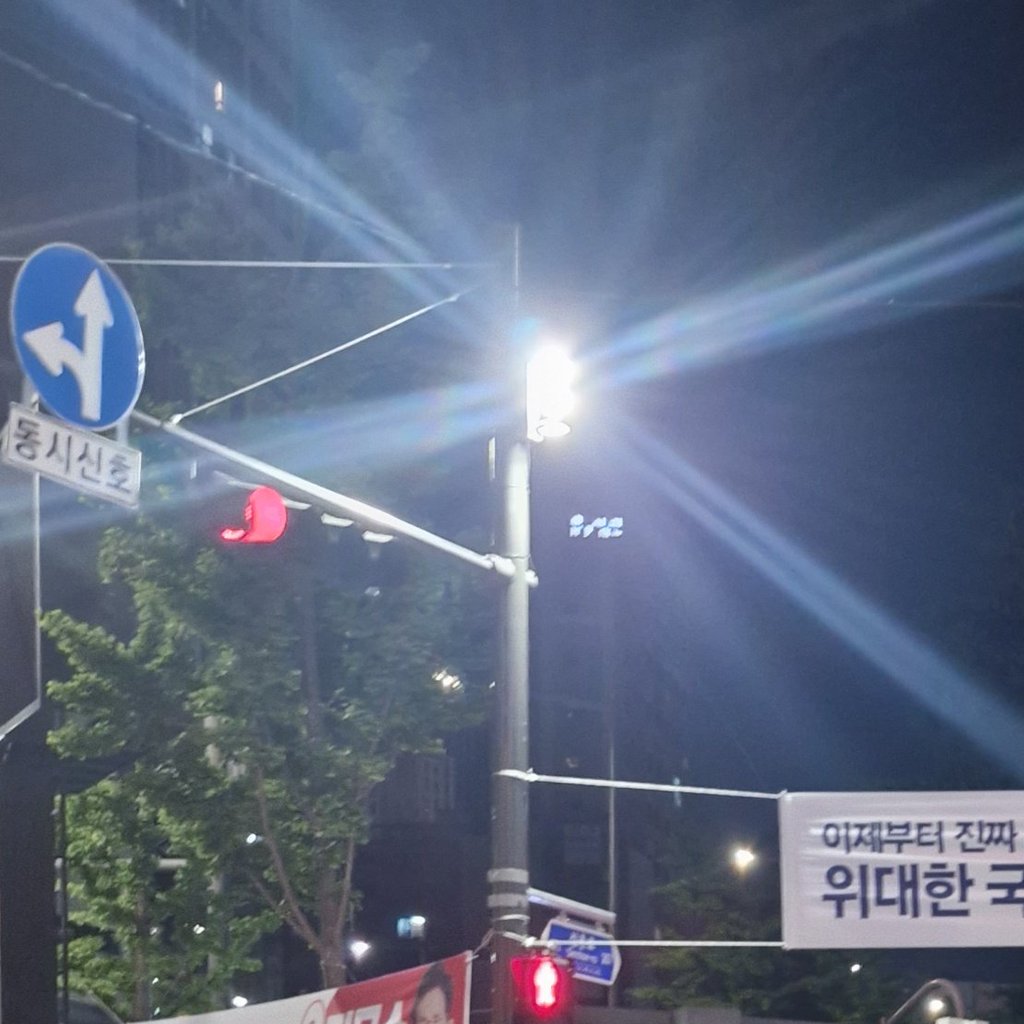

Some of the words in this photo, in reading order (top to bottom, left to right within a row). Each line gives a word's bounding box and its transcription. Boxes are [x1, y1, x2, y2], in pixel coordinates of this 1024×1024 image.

[15, 417, 132, 494] 동시신호
[821, 819, 946, 854] 이제부터
[953, 819, 1018, 853] 진짜
[821, 861, 975, 919] 위대한
